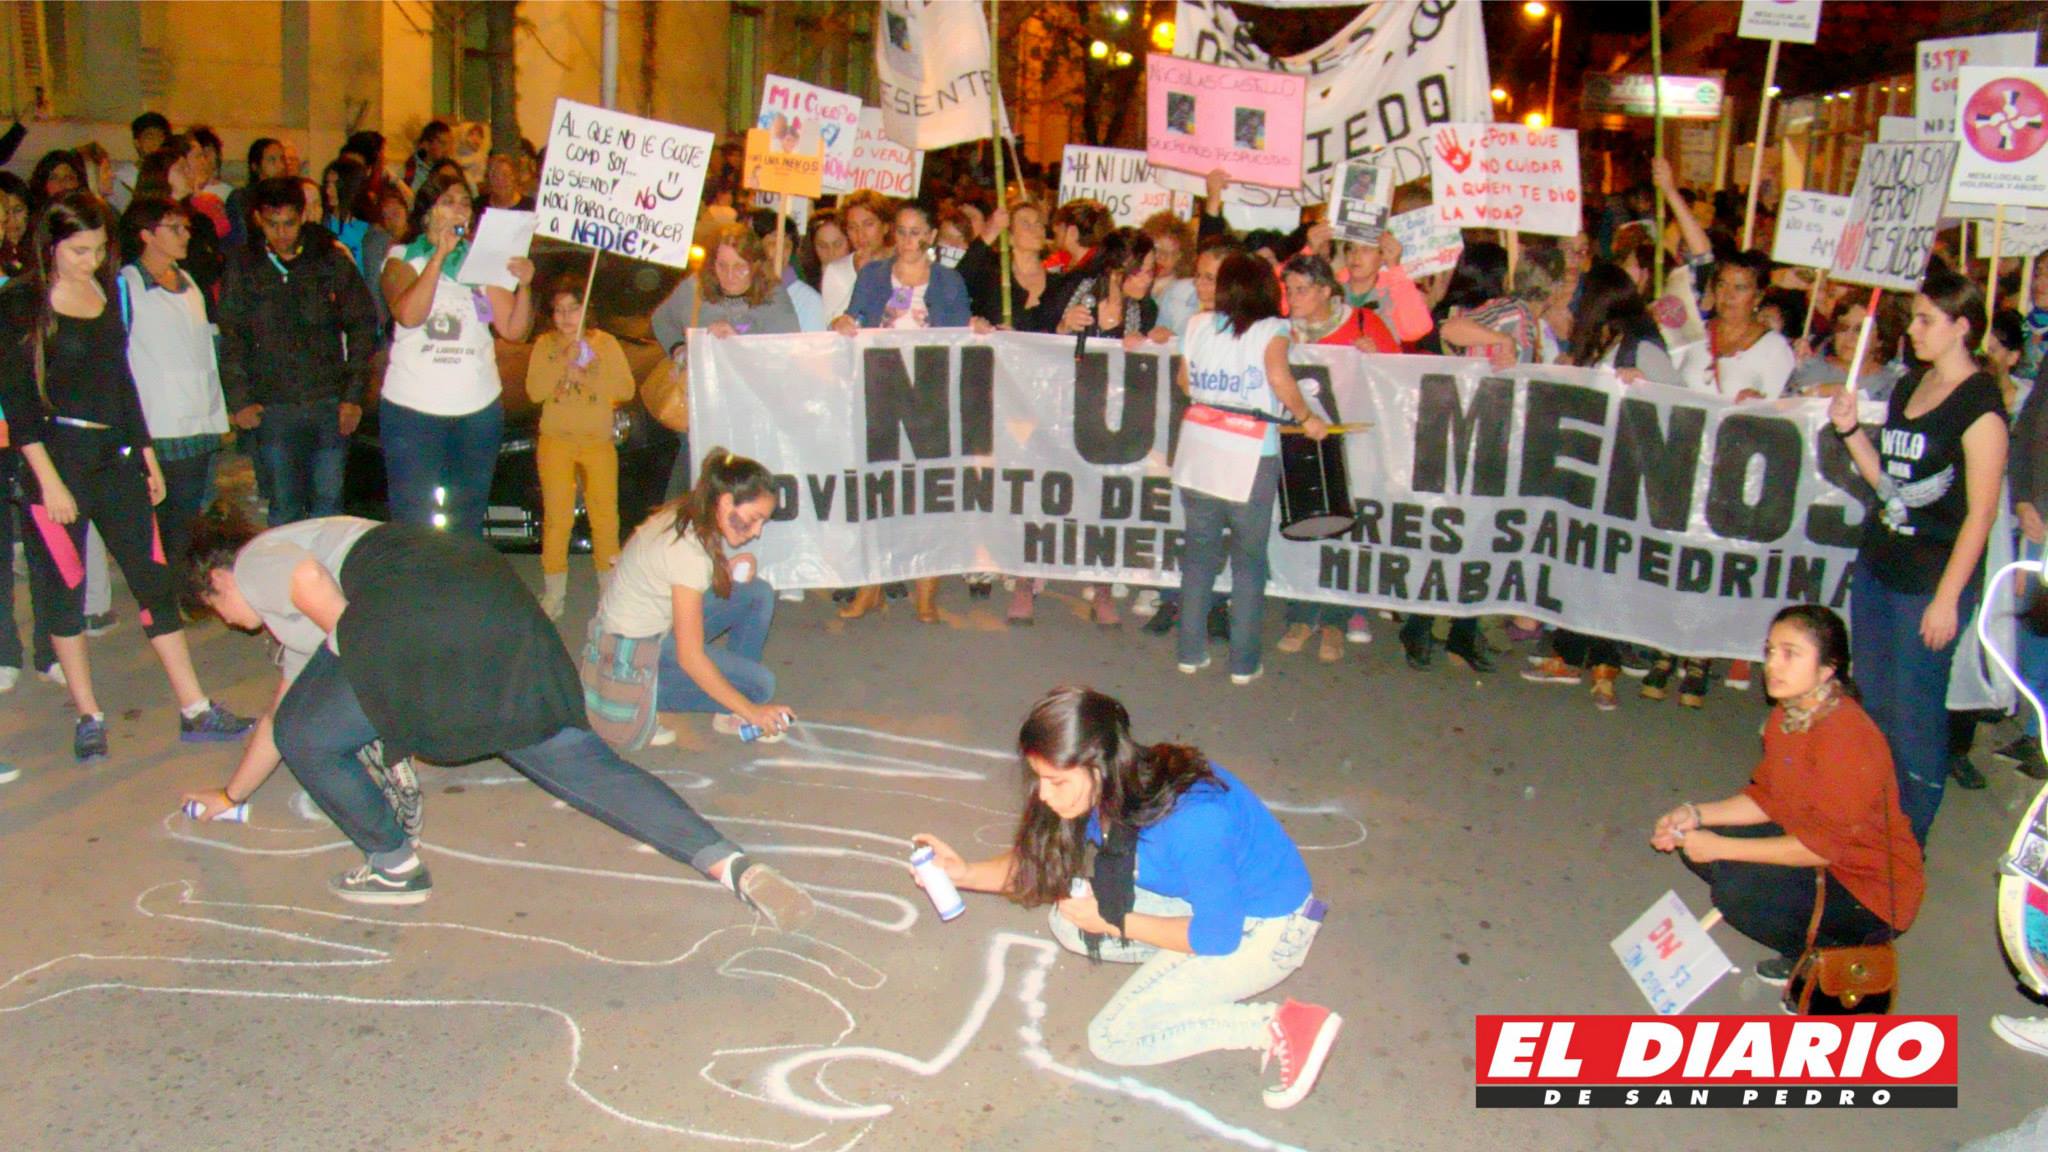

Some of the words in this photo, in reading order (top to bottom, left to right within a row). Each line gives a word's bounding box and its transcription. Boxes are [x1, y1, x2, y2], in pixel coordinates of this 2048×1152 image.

[557, 110, 580, 139] AL
[587, 120, 613, 145] QUE
[617, 129, 636, 151] NO
[641, 136, 657, 158] LE
[1306, 74, 1449, 174] IEDO
[1526, 131, 1560, 148] QUE
[1480, 158, 1501, 174] NO
[1505, 158, 1563, 174] CUIDAR
[634, 186, 657, 210] NO
[1445, 183, 1457, 198] A
[1462, 181, 1512, 198] QUIEN
[1520, 184, 1542, 202] TE
[1441, 206, 1464, 221] LA
[863, 345, 994, 462] NI
[1100, 474, 1173, 523] DE
[1319, 544, 1562, 614] MIRABAL
